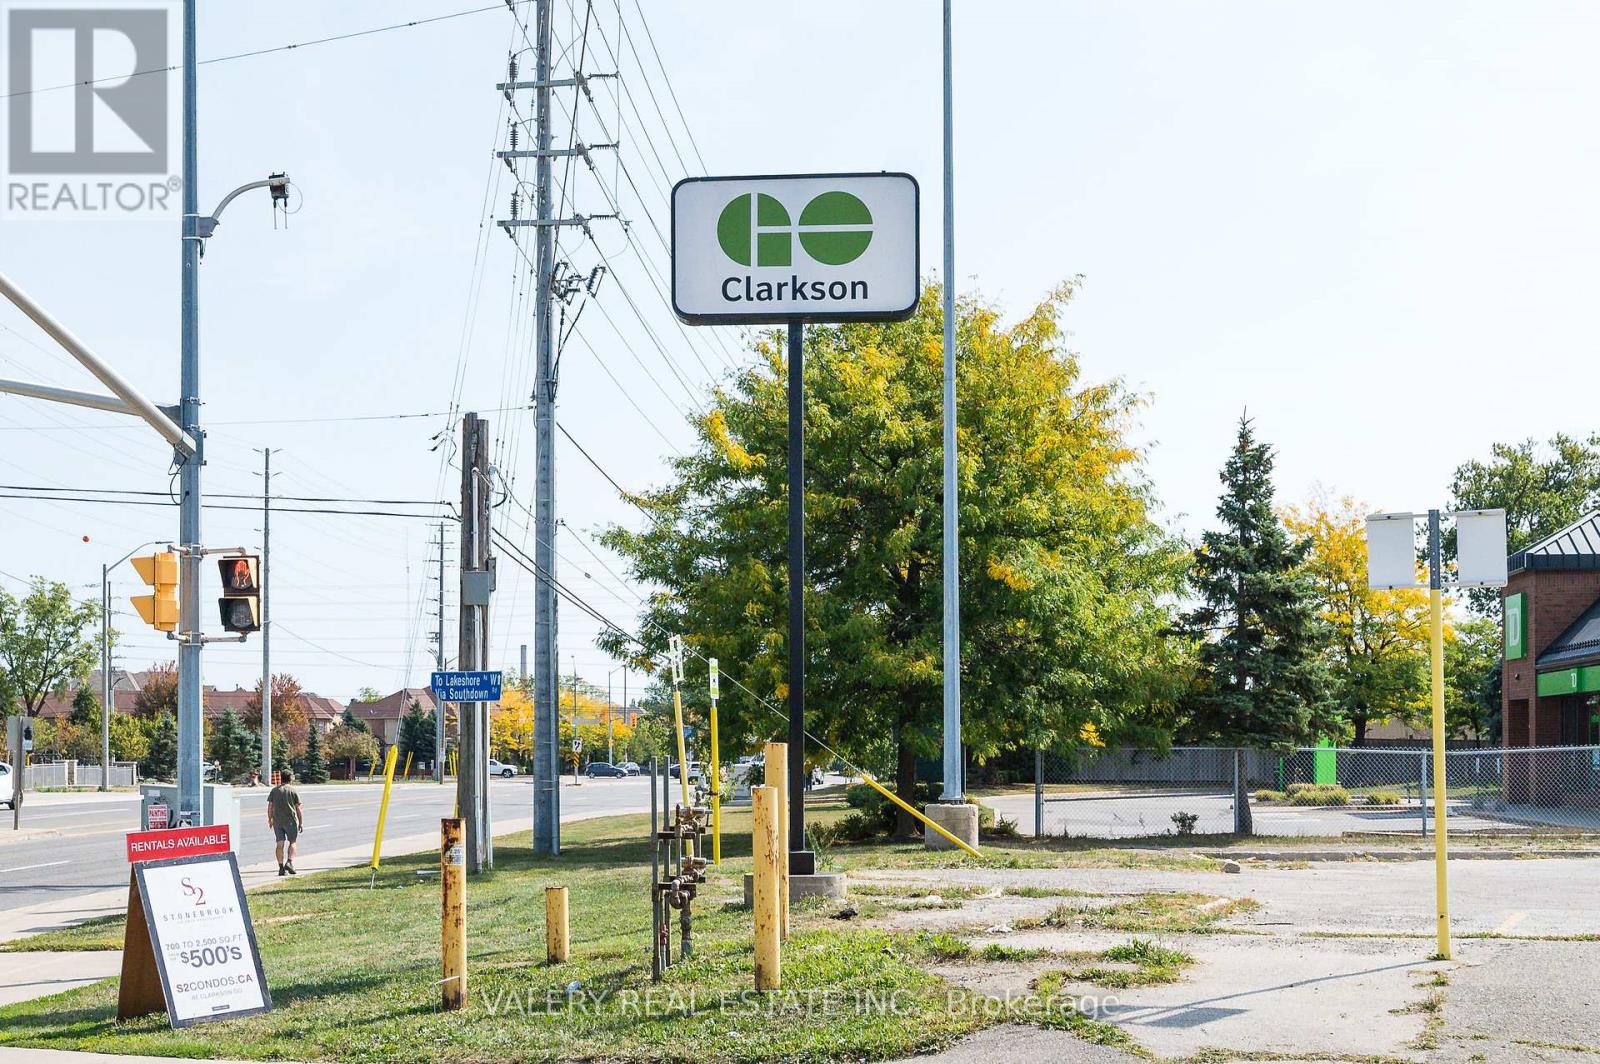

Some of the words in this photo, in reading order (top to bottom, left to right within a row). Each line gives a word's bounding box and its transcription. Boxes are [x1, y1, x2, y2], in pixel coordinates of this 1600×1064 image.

[721, 275, 869, 301] Clarkson
[435, 674, 443, 686] To
[446, 674, 481, 686] Lakeshore
[435, 688, 446, 700] Via
[449, 688, 489, 700] Southdown
[131, 839, 175, 852] RENTALS
[177, 834, 227, 848] AVAILABLE
[163, 907, 234, 921] STONEBROOK
[165, 942, 180, 951] 700
[183, 941, 193, 949] TO
[176, 974, 253, 993] S2CONDOS.CA
